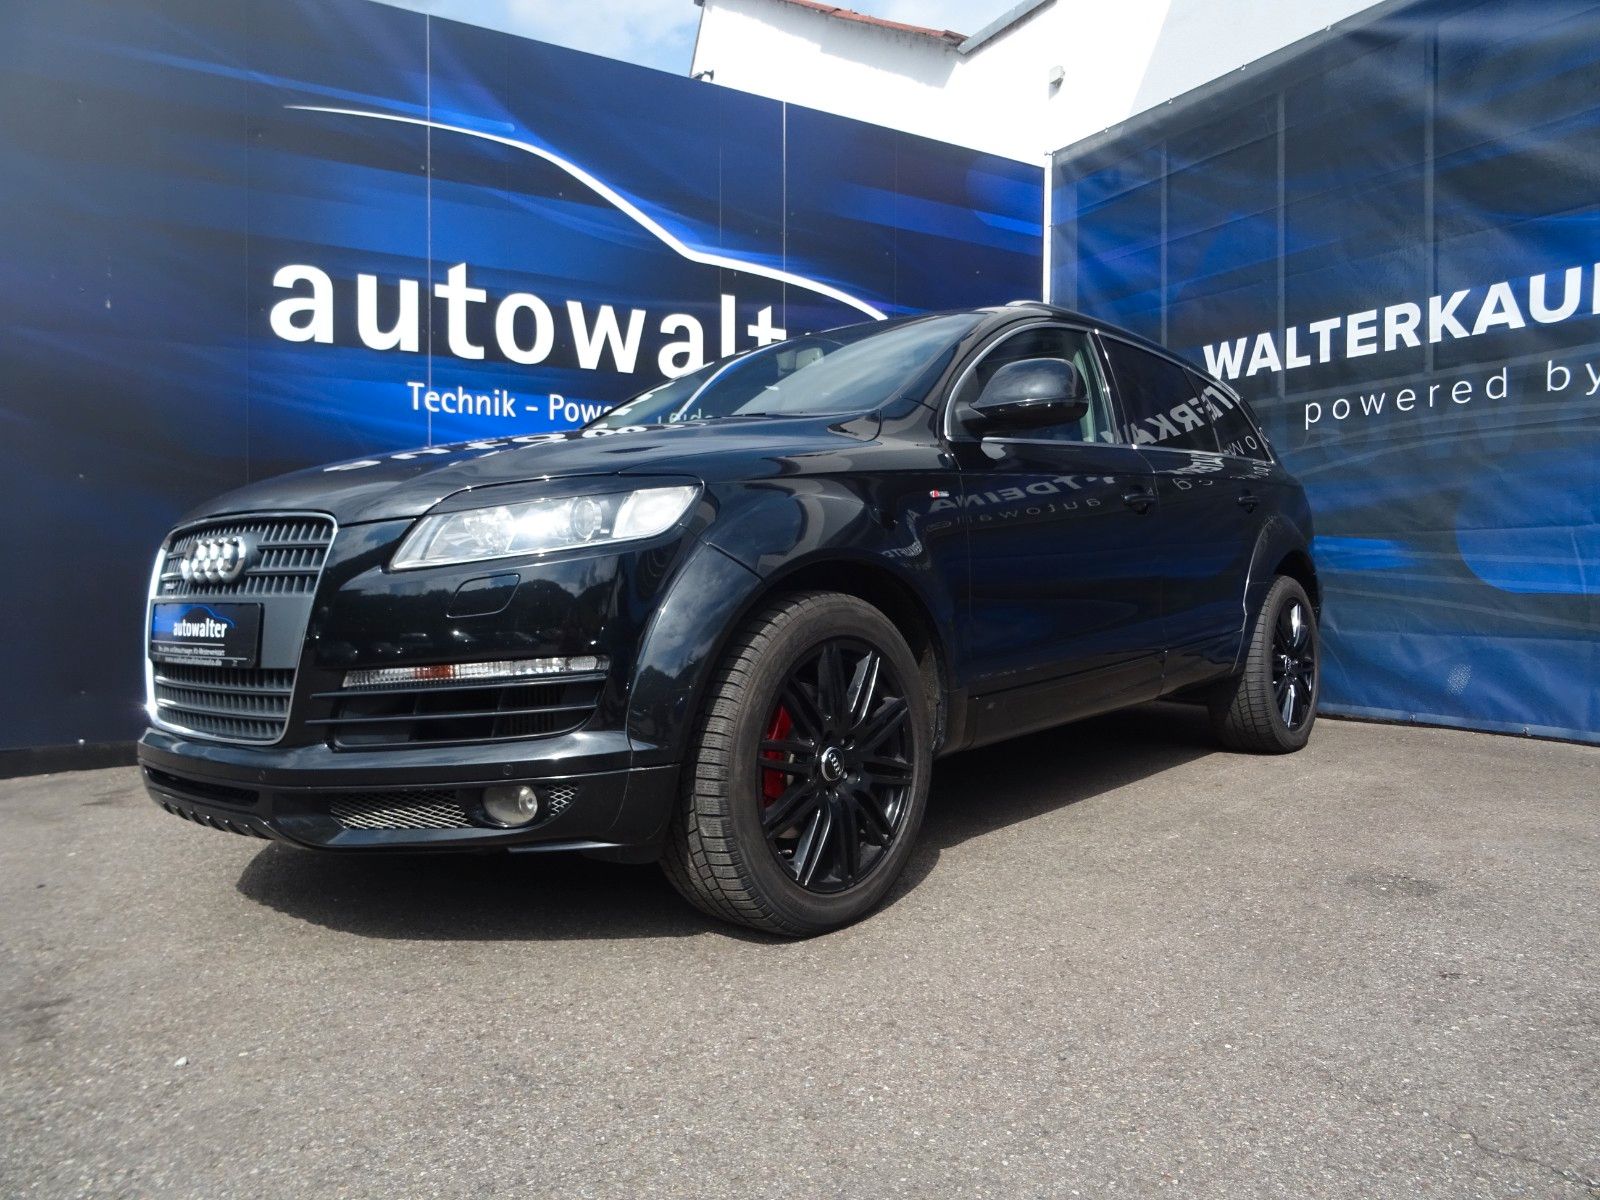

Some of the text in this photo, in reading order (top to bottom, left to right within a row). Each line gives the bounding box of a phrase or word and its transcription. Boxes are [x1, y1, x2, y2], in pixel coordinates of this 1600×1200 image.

[406, 381, 517, 418] Technik
[549, 393, 613, 424] Pow
[1305, 359, 1600, 431] powered by
[173, 618, 228, 638] autowalter
